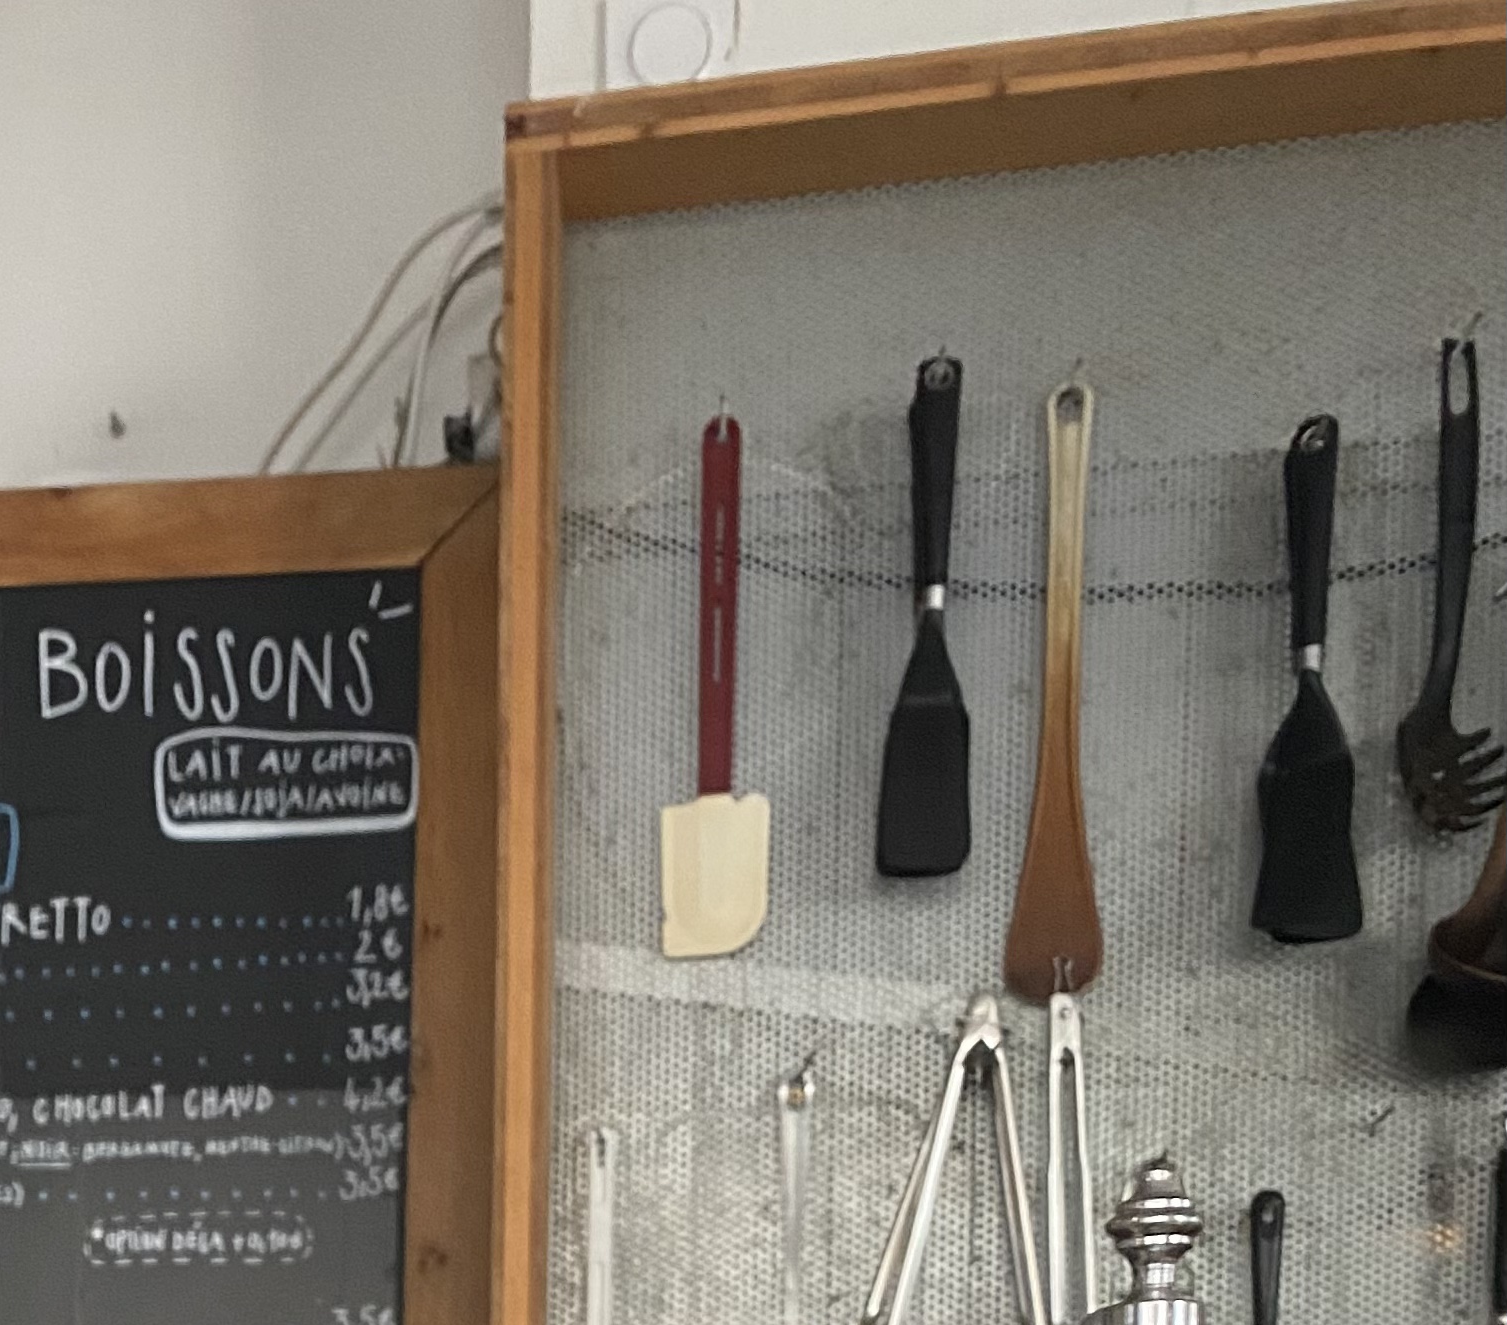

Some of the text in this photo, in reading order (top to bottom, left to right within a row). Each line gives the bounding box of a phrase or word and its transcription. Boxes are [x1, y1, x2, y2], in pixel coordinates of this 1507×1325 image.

[39, 611, 373, 721] BOISSONS
[168, 737, 243, 782] LAIT
[258, 749, 302, 775] AU
[33, 1084, 164, 1126] CHOCOLAT
[184, 1084, 273, 1119] CHAUD
